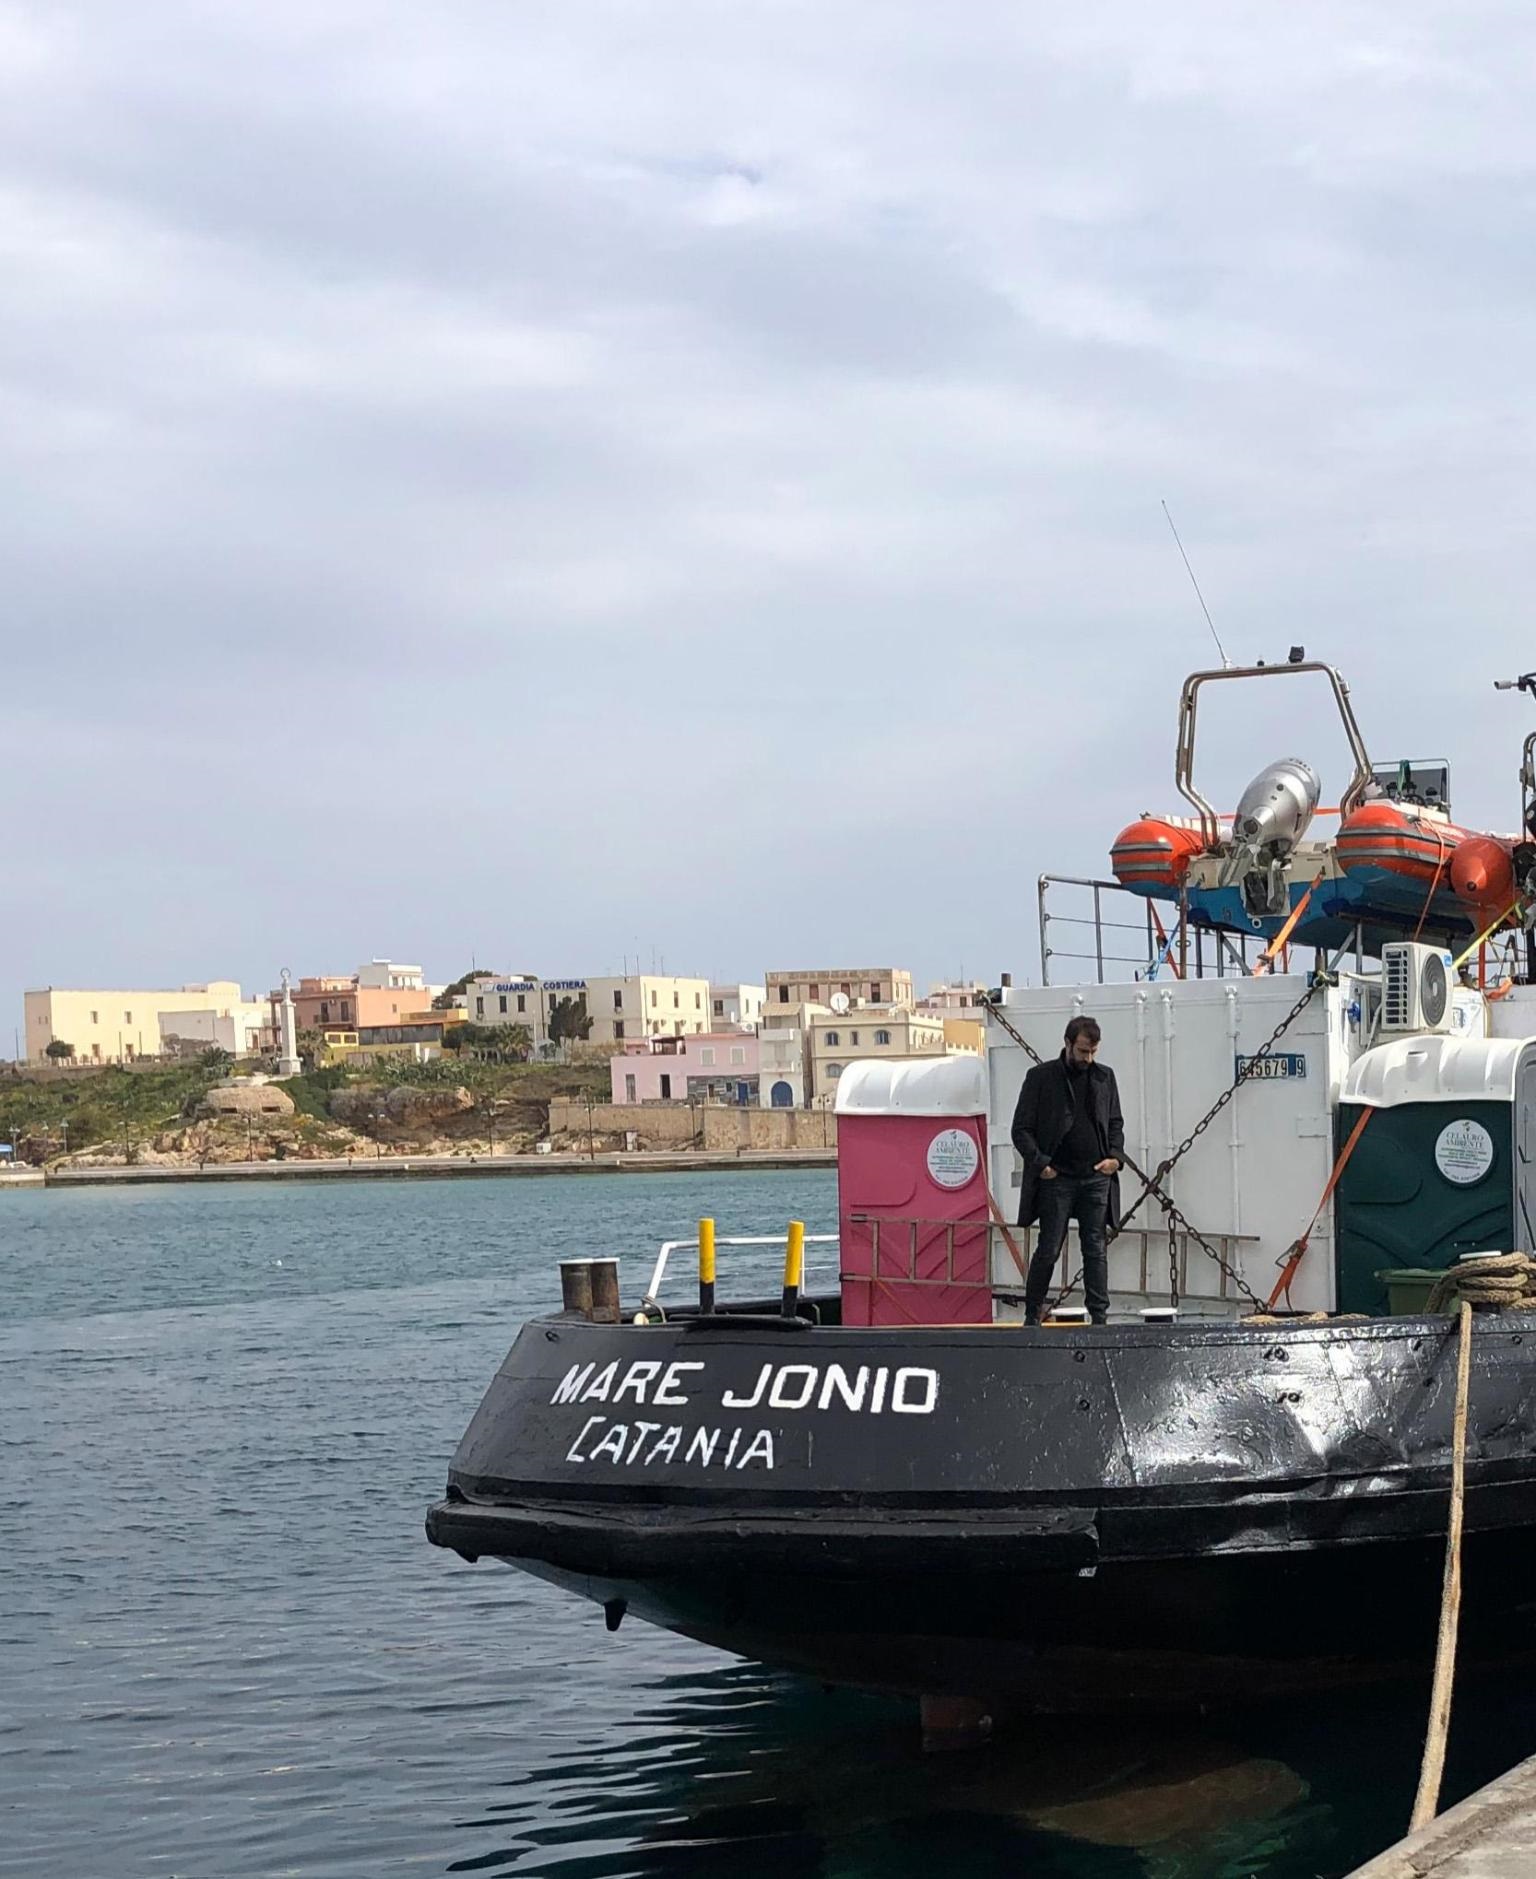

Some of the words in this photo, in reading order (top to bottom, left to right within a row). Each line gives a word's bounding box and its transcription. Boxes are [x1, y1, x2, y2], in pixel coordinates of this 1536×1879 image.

[496, 983, 535, 992] GUARDIA
[543, 980, 586, 990] COSTIERA
[549, 1360, 705, 1406] MARE
[721, 1363, 938, 1414] JONIO
[565, 1416, 775, 1471] CATANIA
